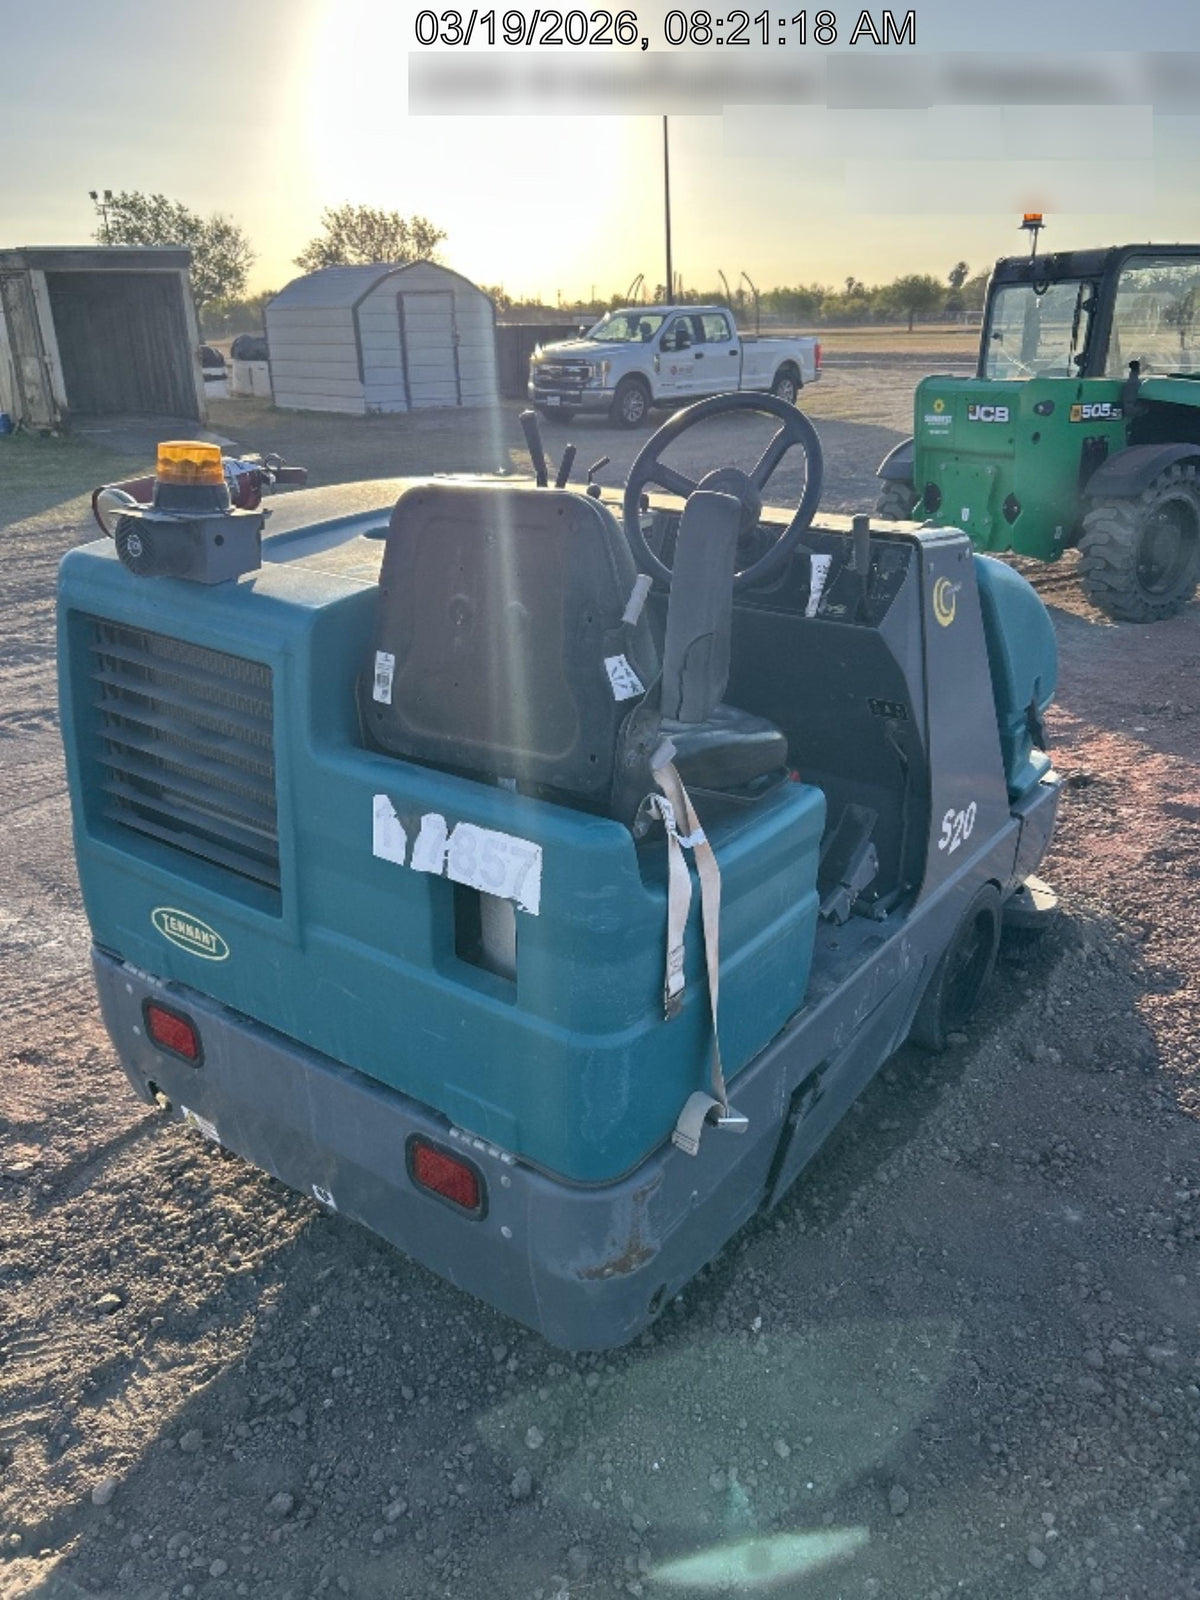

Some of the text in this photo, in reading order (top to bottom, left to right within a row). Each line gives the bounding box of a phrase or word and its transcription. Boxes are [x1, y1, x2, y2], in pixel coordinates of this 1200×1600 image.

[968, 404, 1009, 422] JCB
[938, 801, 977, 855] S20
[161, 913, 217, 953] TENNANT
